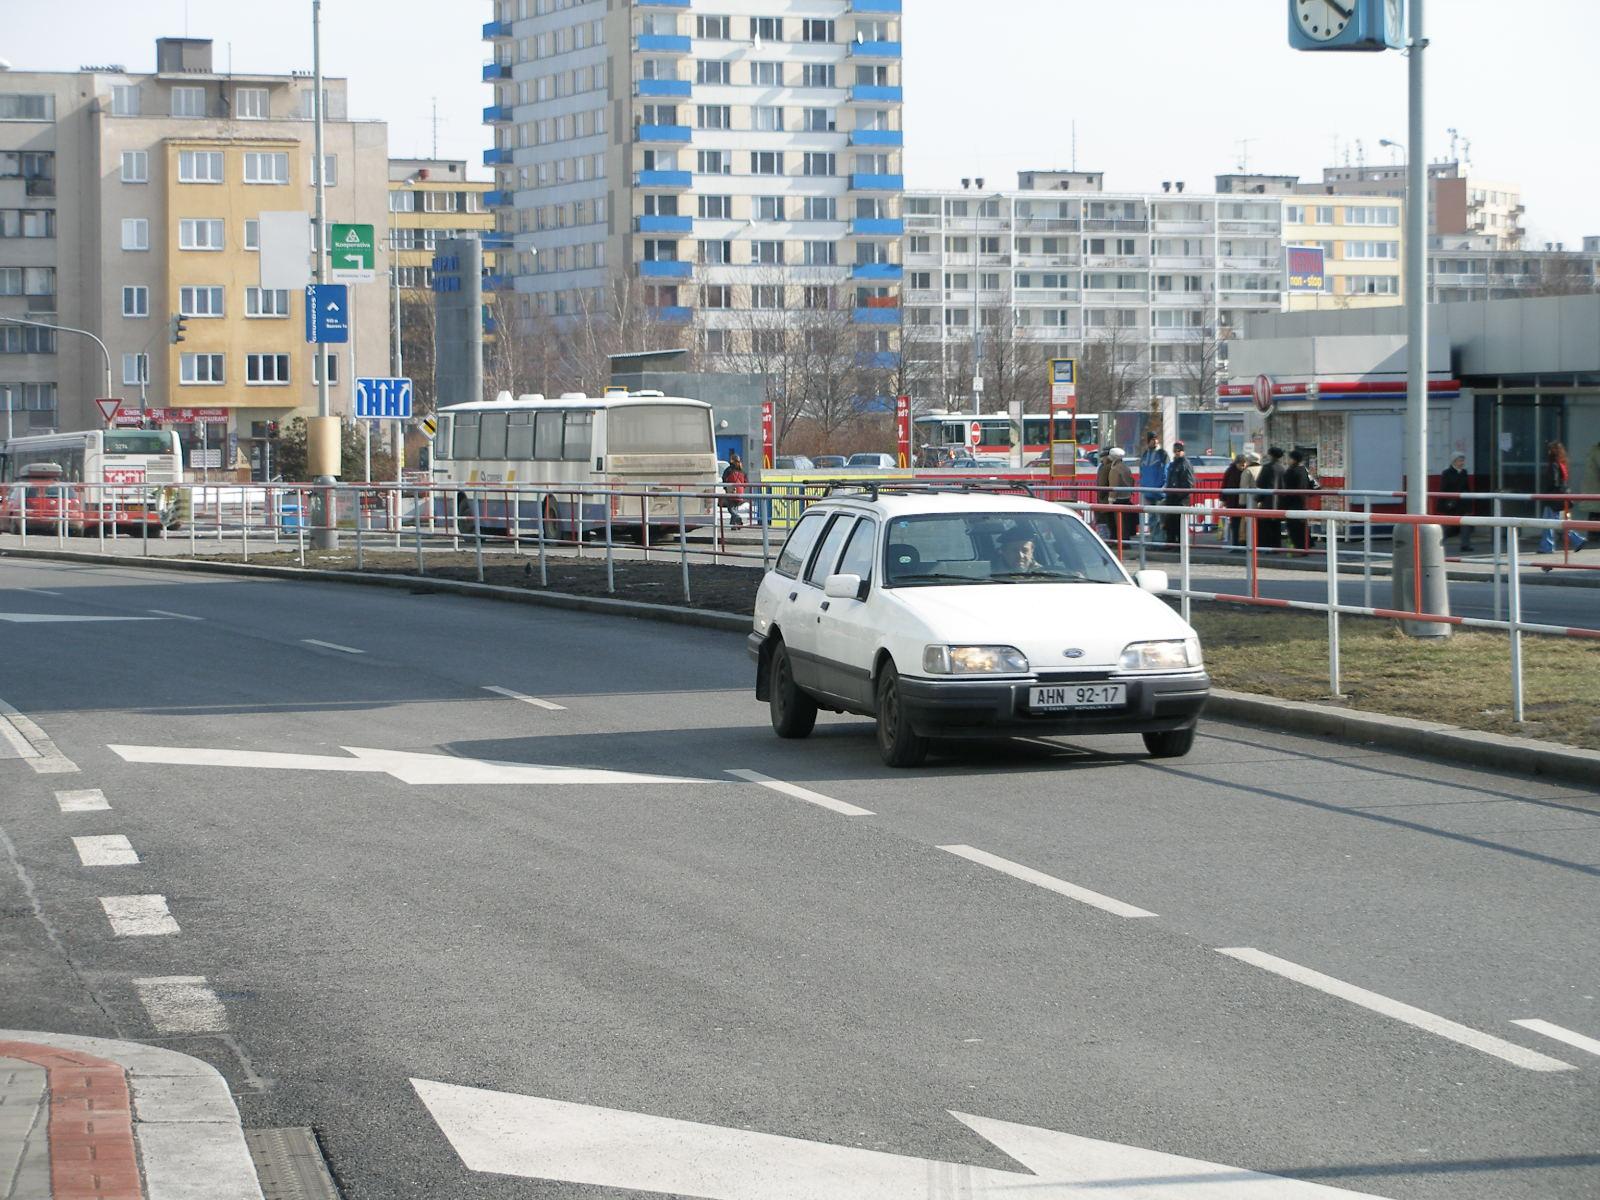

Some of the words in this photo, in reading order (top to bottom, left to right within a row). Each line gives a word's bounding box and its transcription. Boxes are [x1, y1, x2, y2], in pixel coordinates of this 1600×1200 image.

[335, 242, 371, 250] Kooperativa
[1037, 688, 1065, 704] AHN
[1076, 686, 1119, 703] 92-17
